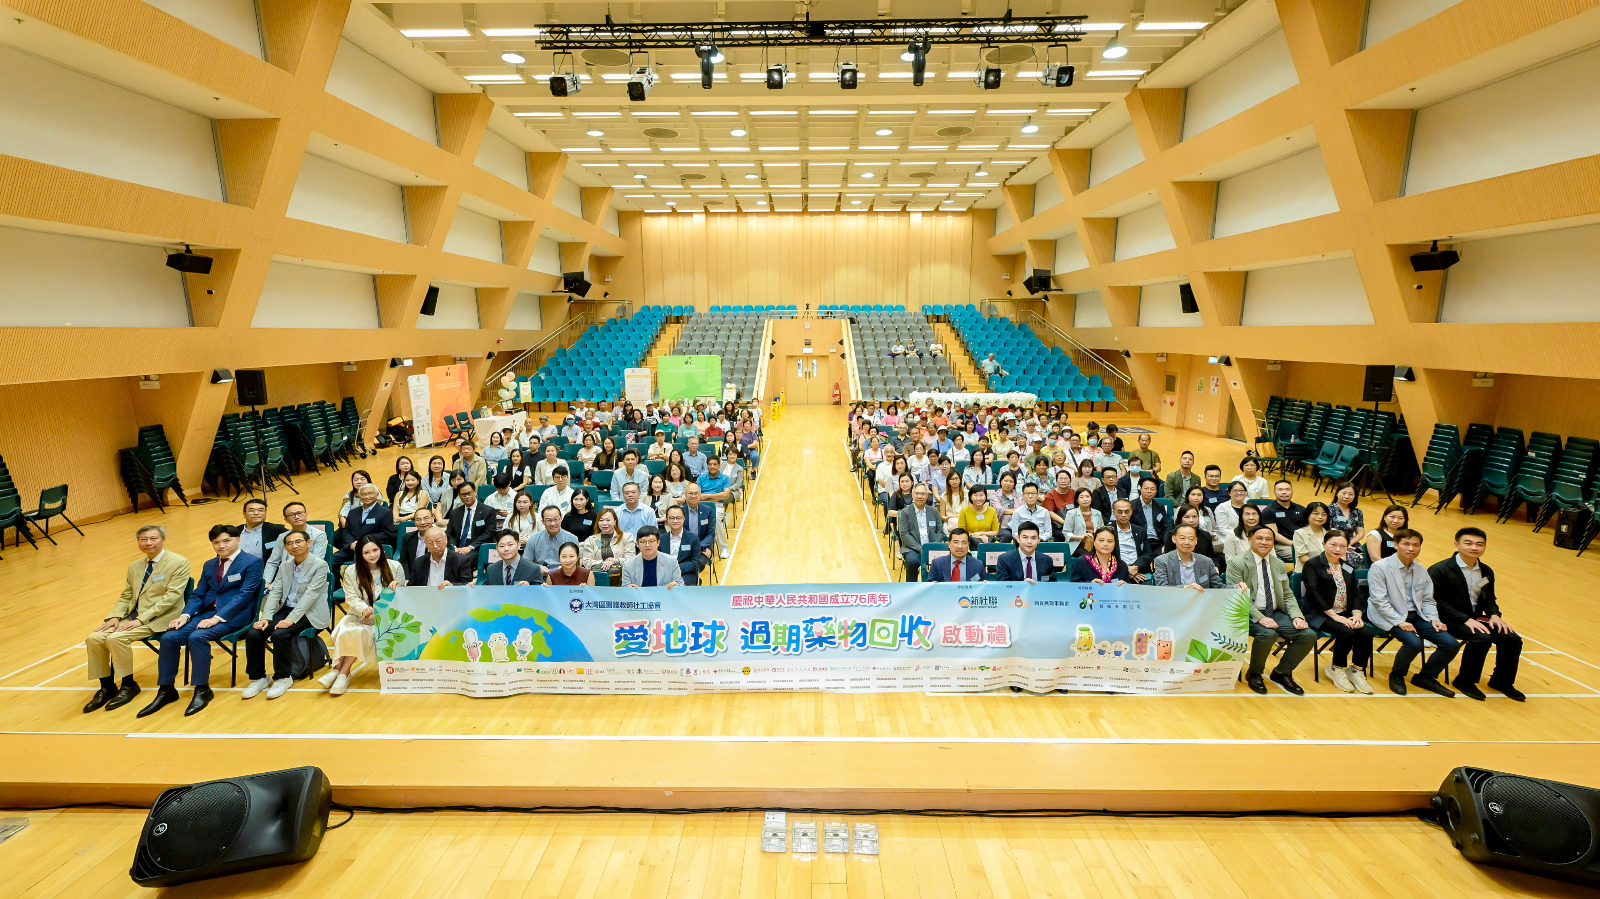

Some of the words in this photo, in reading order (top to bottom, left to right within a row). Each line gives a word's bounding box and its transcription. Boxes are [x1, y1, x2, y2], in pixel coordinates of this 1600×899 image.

[731, 592, 889, 607] 慶祝中華人民共和國成立76周年
[970, 595, 997, 605] 新社聯
[613, 619, 727, 655] 愛地球
[740, 615, 932, 653] 過期藥物回收
[943, 624, 1008, 646] 啟動禮
